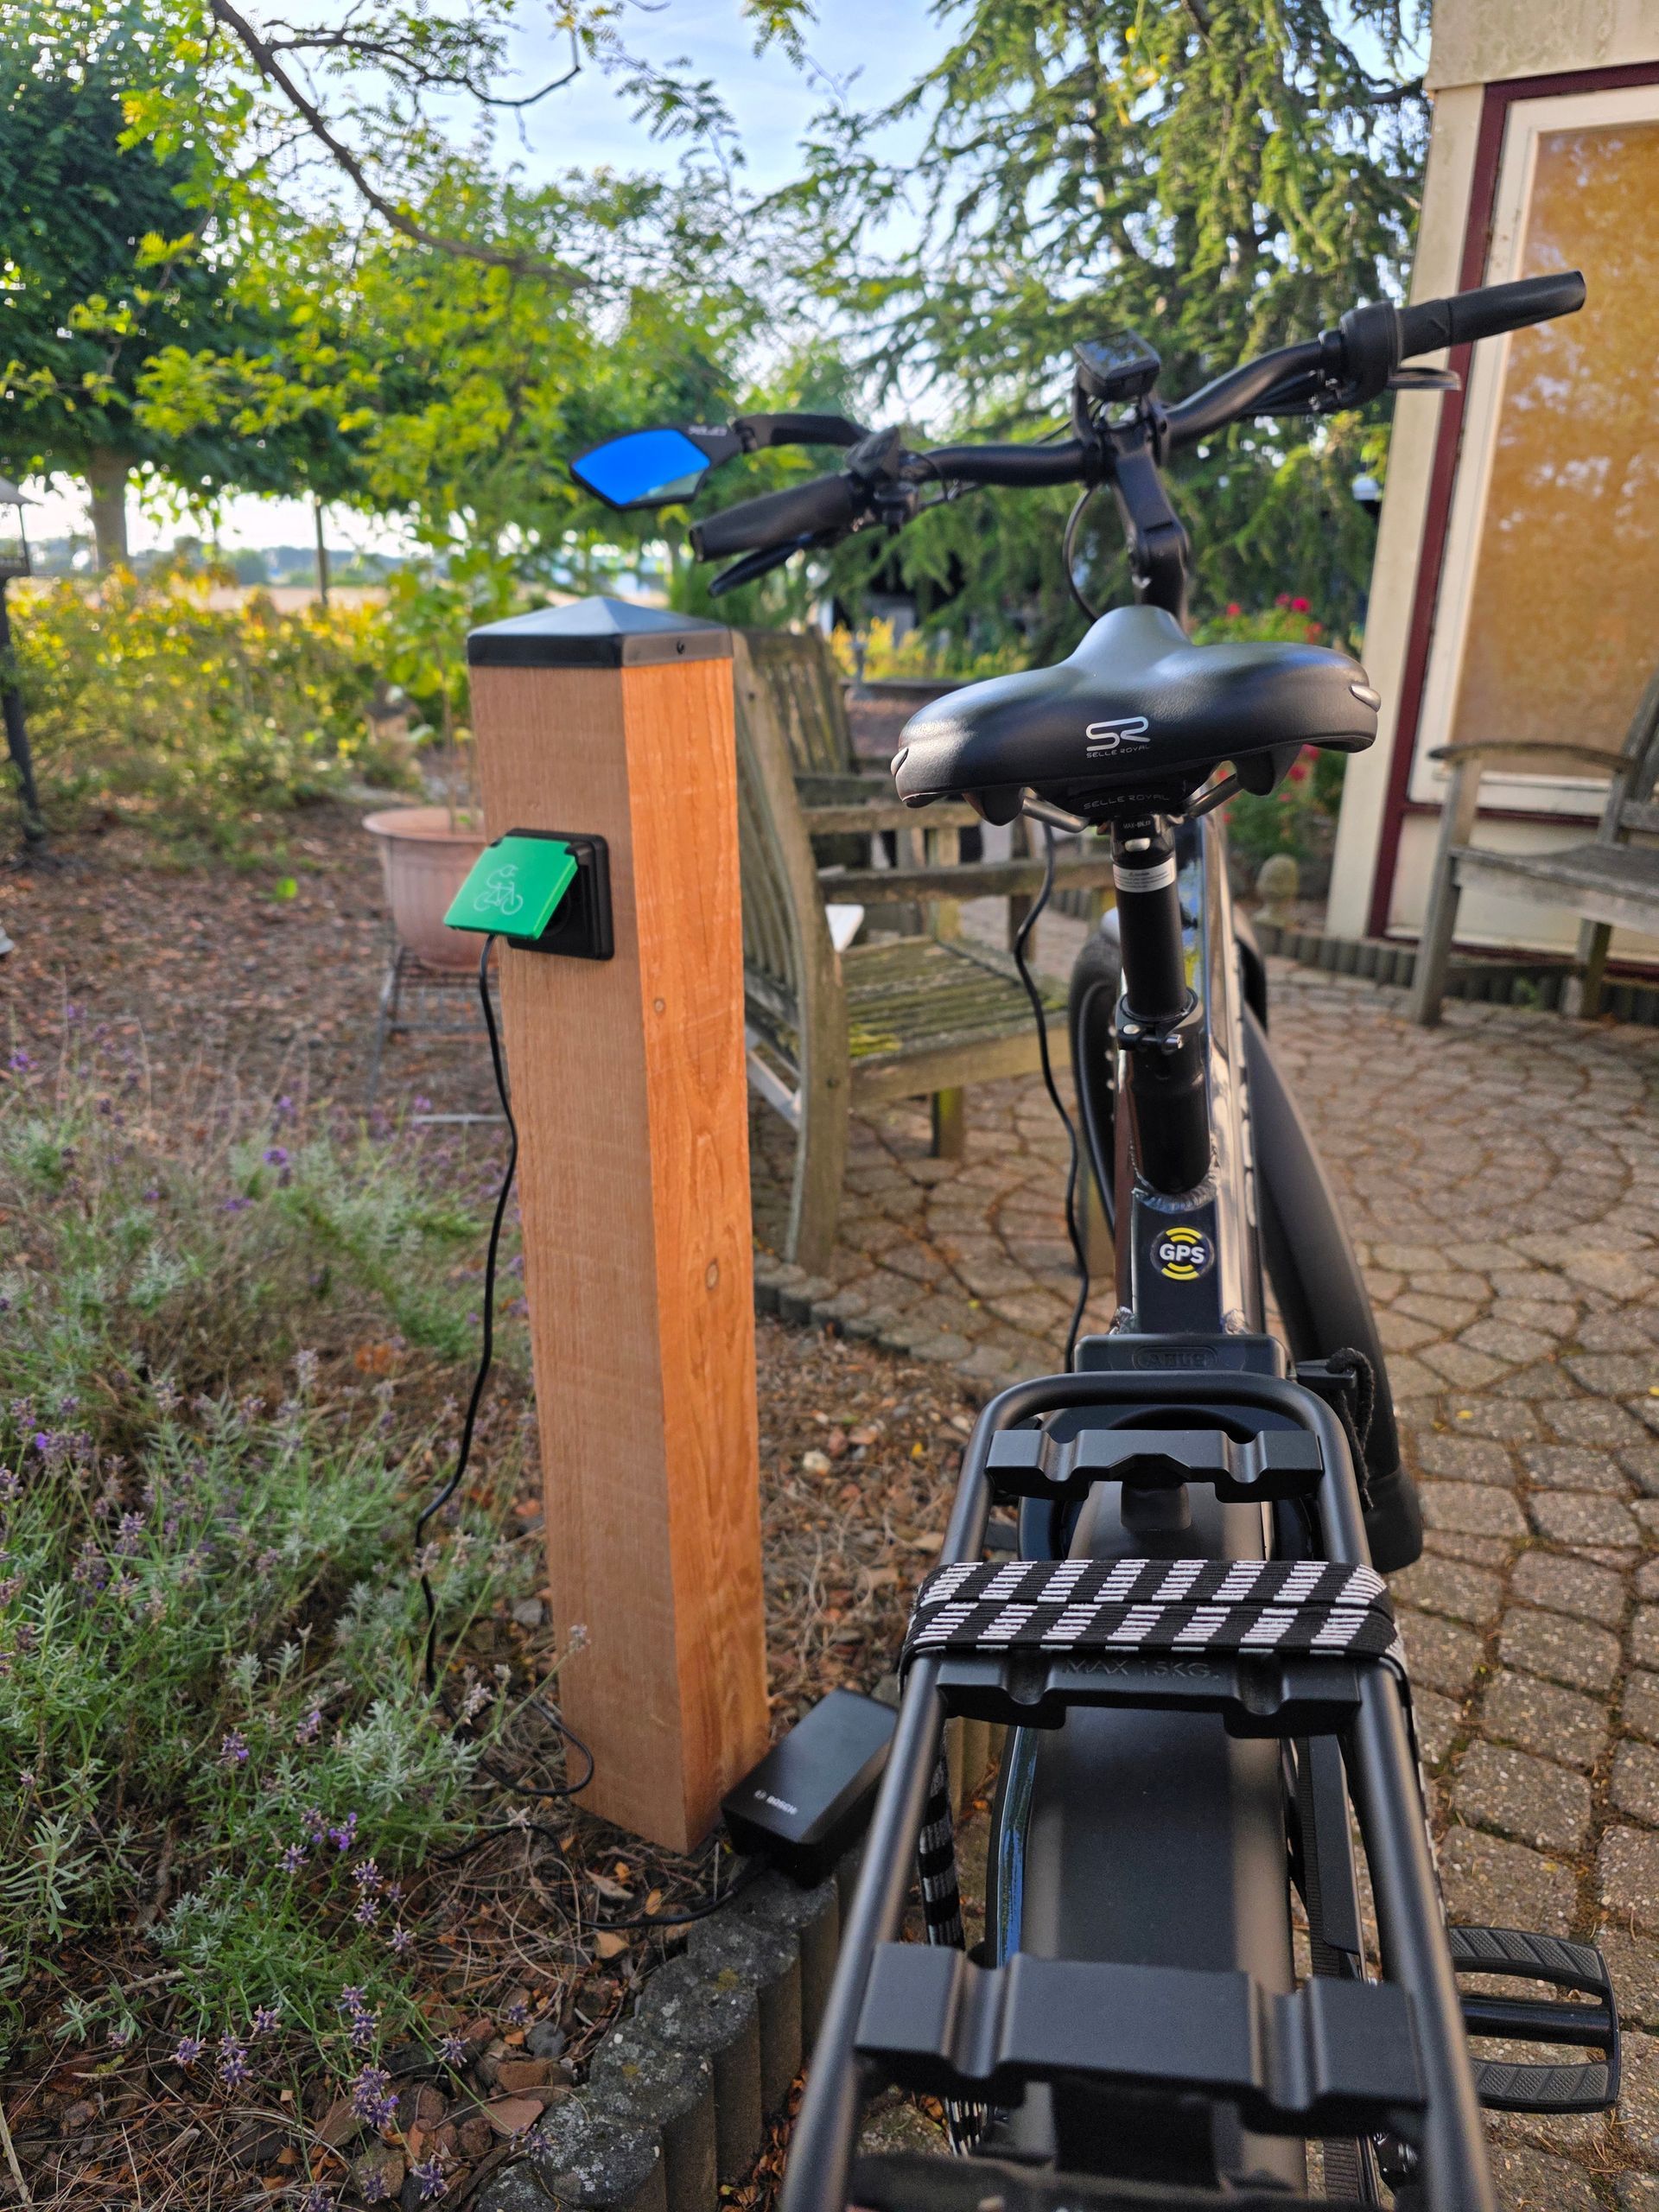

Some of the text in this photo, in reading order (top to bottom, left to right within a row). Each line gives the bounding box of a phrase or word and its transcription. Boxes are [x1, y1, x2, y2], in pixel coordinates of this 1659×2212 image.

[1086, 716, 1151, 752] SR
[1086, 745, 1149, 759] SELLE ROYAL
[1084, 795, 1125, 810] SELLE
[1159, 1243, 1205, 1264] GPS
[1065, 1658, 1129, 1676] MAX
